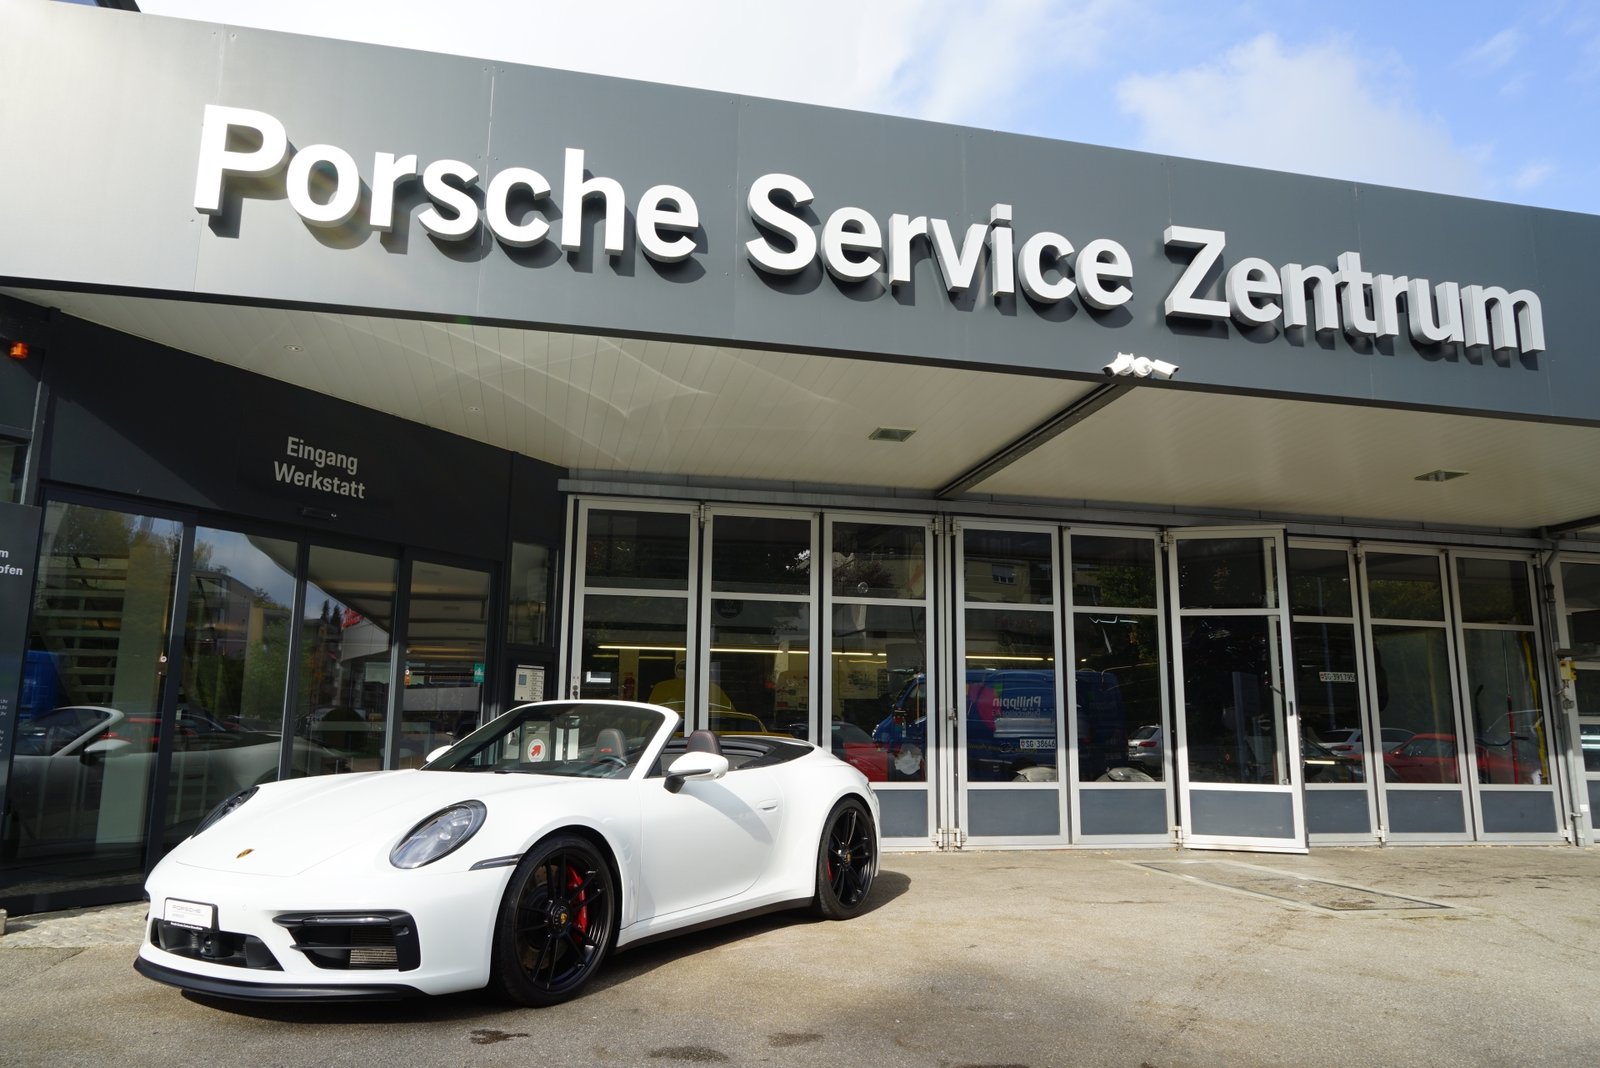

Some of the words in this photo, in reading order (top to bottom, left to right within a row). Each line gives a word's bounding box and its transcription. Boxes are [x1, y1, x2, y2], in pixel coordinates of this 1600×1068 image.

[194, 104, 701, 263] Porsche
[745, 173, 1134, 311] Service
[1164, 225, 1546, 354] Zentrum
[287, 436, 358, 475] Eingang
[274, 460, 365, 499] Werkstatt
[1026, 740, 1034, 748] SG
